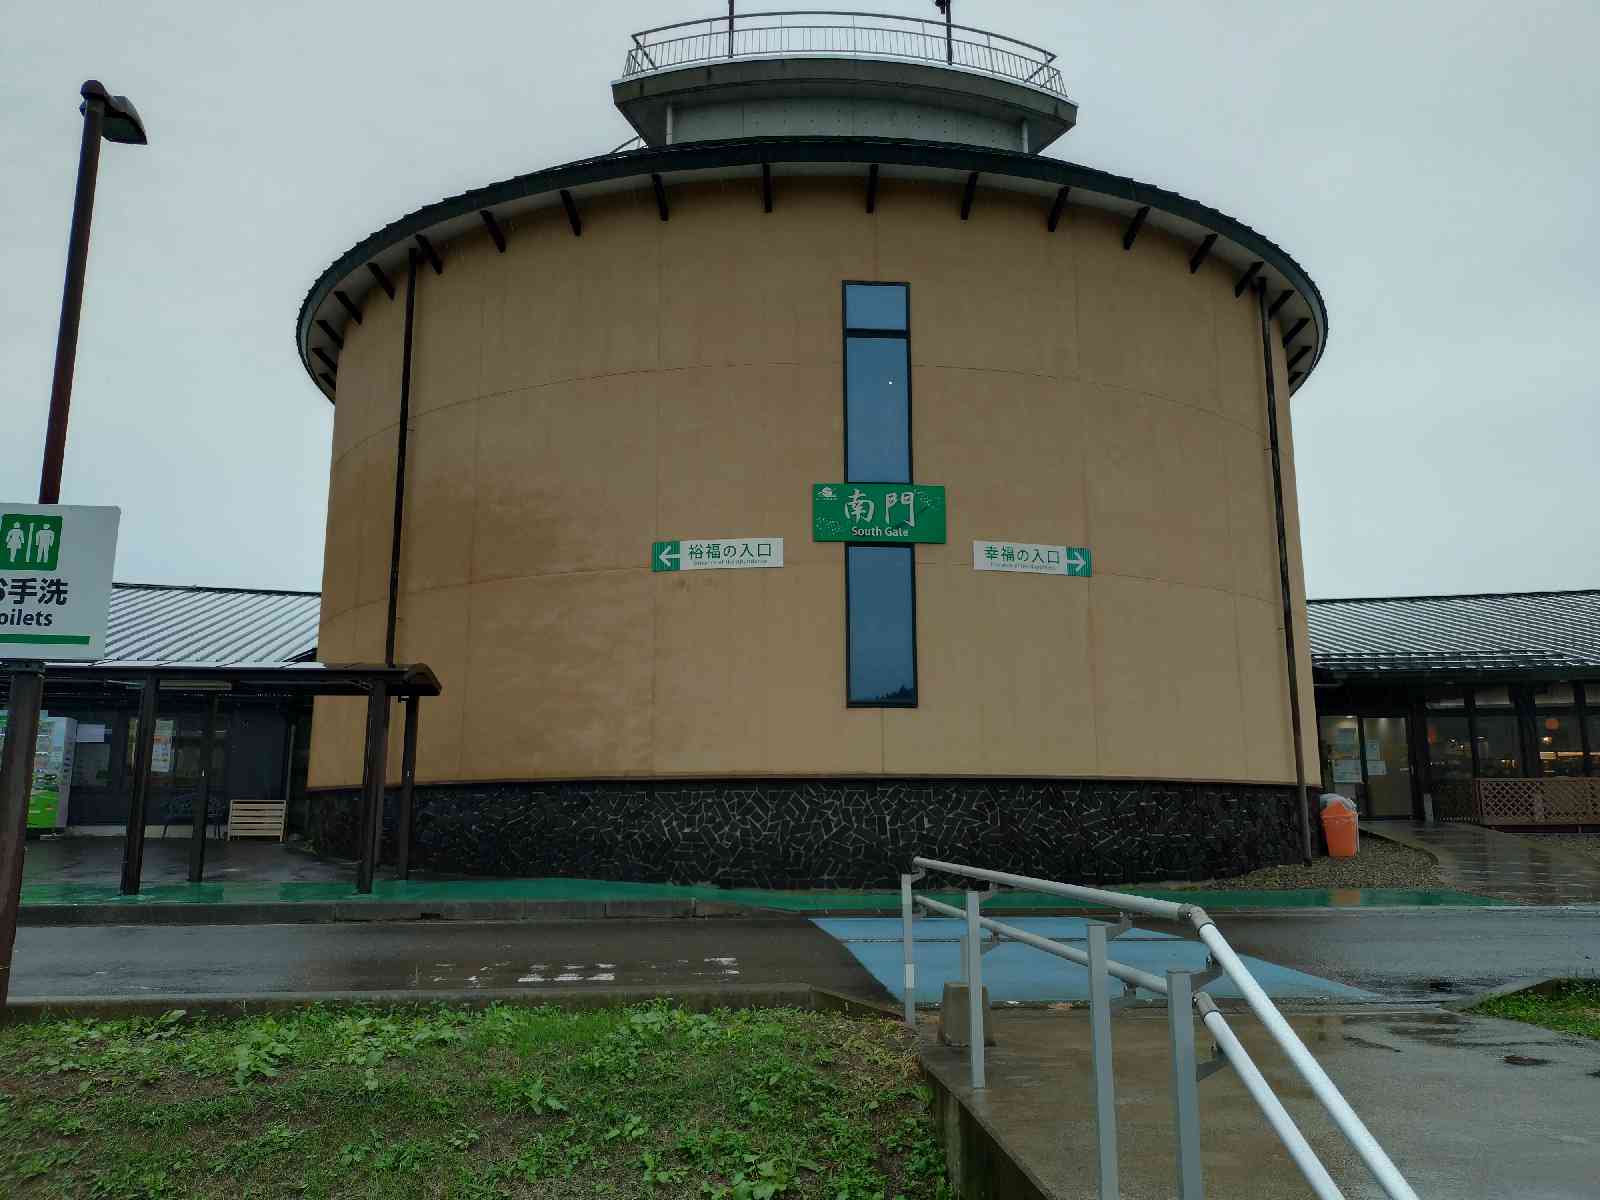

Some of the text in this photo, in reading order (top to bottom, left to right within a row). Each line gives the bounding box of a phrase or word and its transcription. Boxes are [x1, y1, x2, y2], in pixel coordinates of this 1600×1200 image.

[844, 488, 915, 526] 南門
[852, 526, 909, 537] South Gate
[688, 543, 771, 560] 裕福の入口
[984, 544, 1059, 564] 幸福の入口
